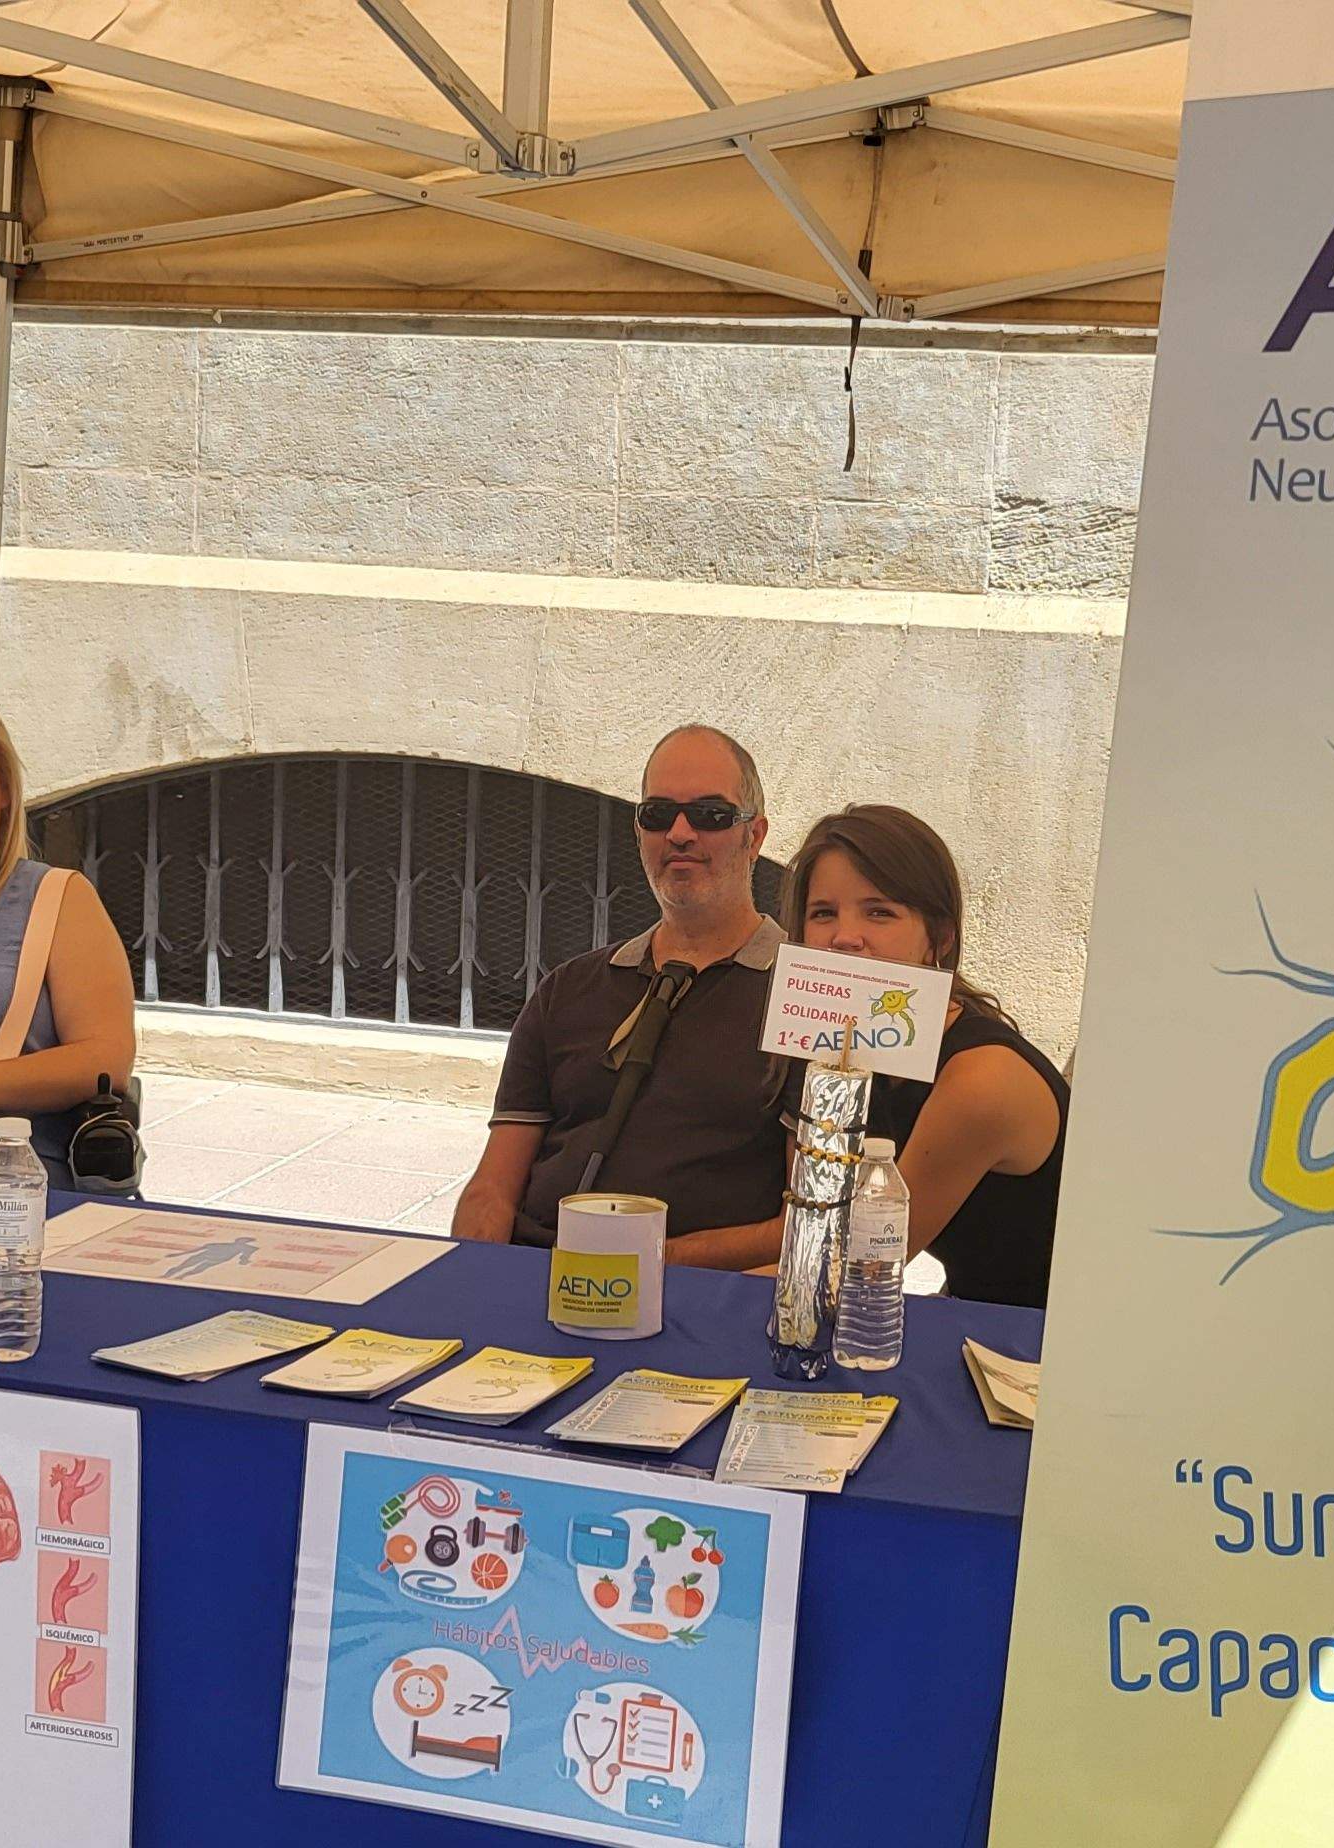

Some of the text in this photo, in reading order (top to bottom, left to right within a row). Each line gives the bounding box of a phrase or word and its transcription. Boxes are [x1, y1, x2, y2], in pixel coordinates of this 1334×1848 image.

[787, 977, 852, 999] PULSERAS
[782, 1003, 858, 1027] SOLIDARIAS
[812, 1027, 901, 1052] AENO
[558, 1274, 632, 1298] AENO
[41, 1533, 105, 1550] HEMORRÁGICO
[45, 1628, 94, 1644] ISQUÉMICO
[434, 1619, 651, 1675] Hábitos Saludables
[30, 1721, 113, 1742] ARTERIOESCLEROSIS
